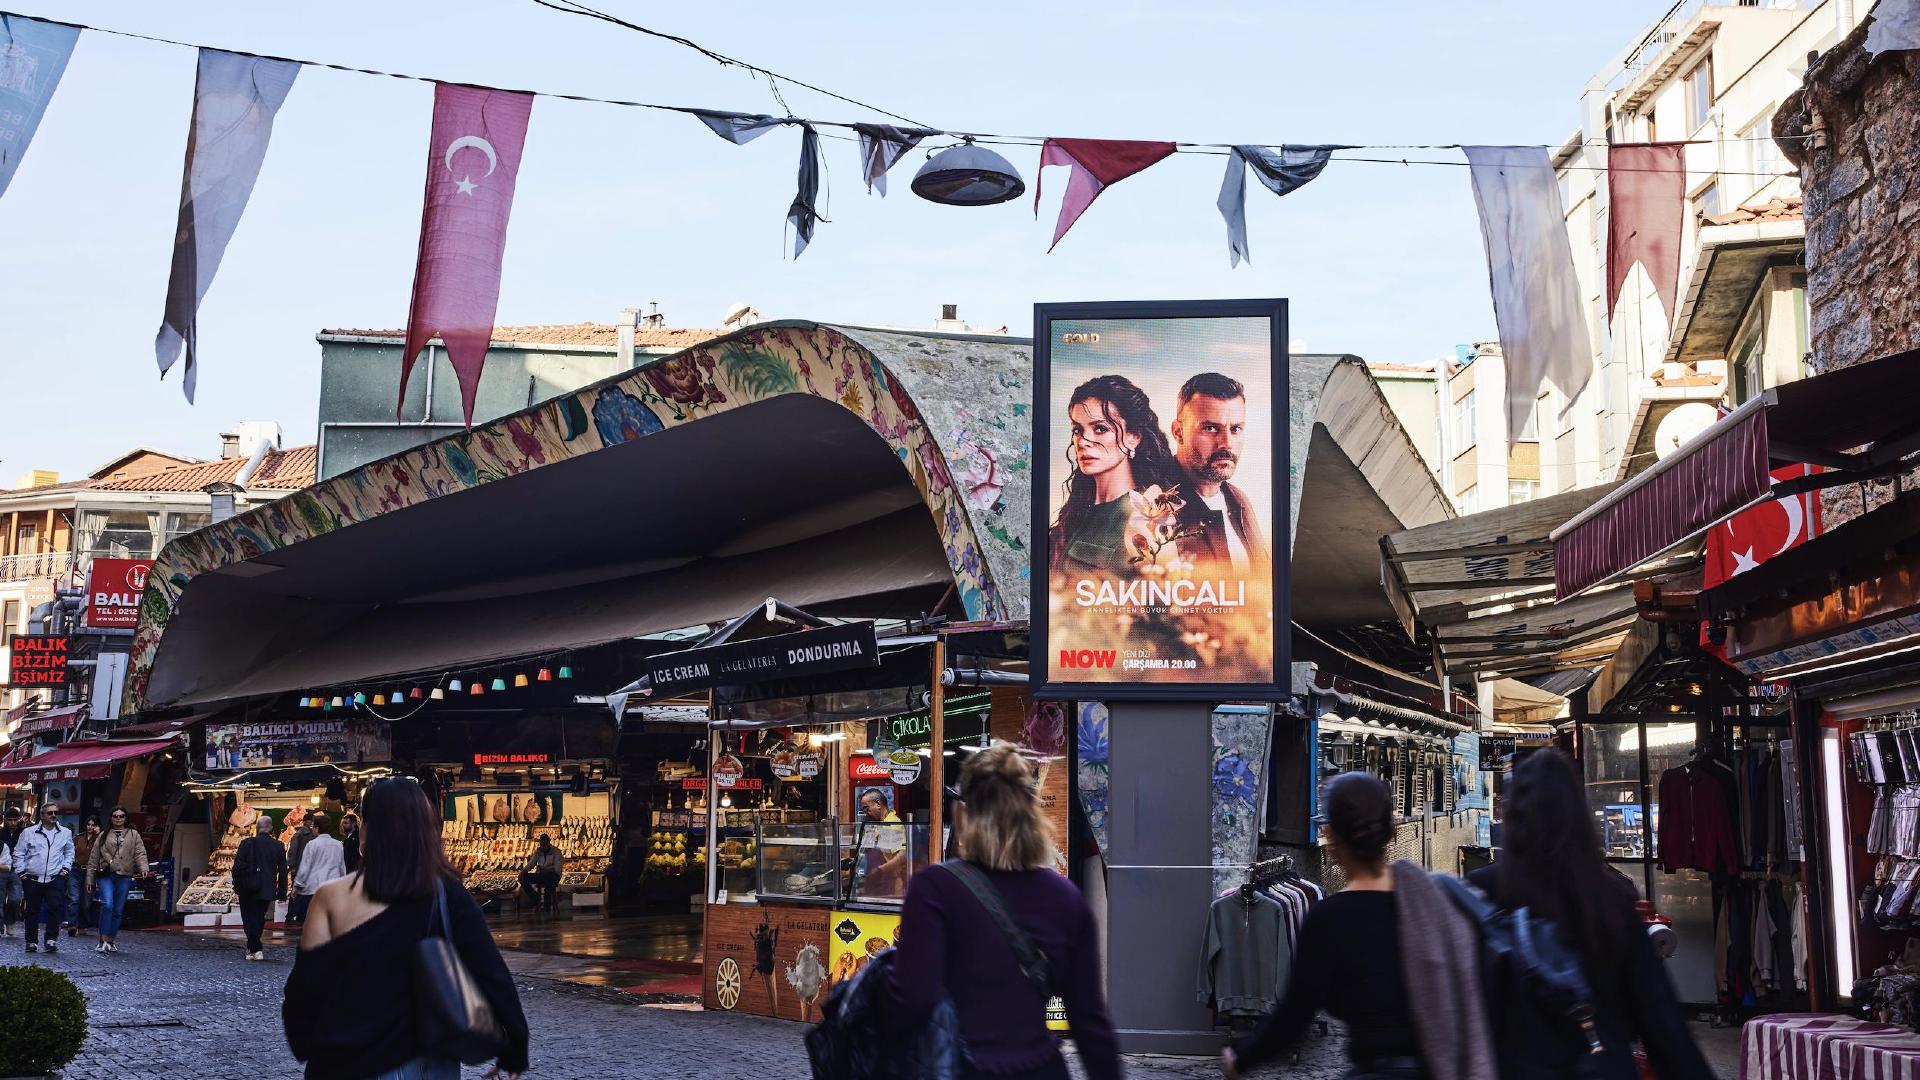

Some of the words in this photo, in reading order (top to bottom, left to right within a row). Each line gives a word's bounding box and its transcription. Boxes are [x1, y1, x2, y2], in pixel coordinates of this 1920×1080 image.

[94, 592, 143, 607] BALI
[1076, 579, 1245, 607] SAKINCALI
[14, 638, 68, 651] BALIK
[12, 651, 66, 668] BİZİM
[654, 668, 673, 684] ICE
[674, 663, 710, 681] CREAM
[788, 640, 862, 664] DONDURMA
[1060, 649, 1117, 669] NOW
[1122, 659, 1169, 671] ÇARŞAMBA
[1171, 659, 1197, 669] 20.00
[14, 671, 65, 685] İŞİMİZ
[243, 725, 294, 737] BALIKÇI
[298, 722, 344, 735] MURAT
[892, 715, 932, 740] ÇİKOLA
[510, 753, 548, 763] BALIKÇI
